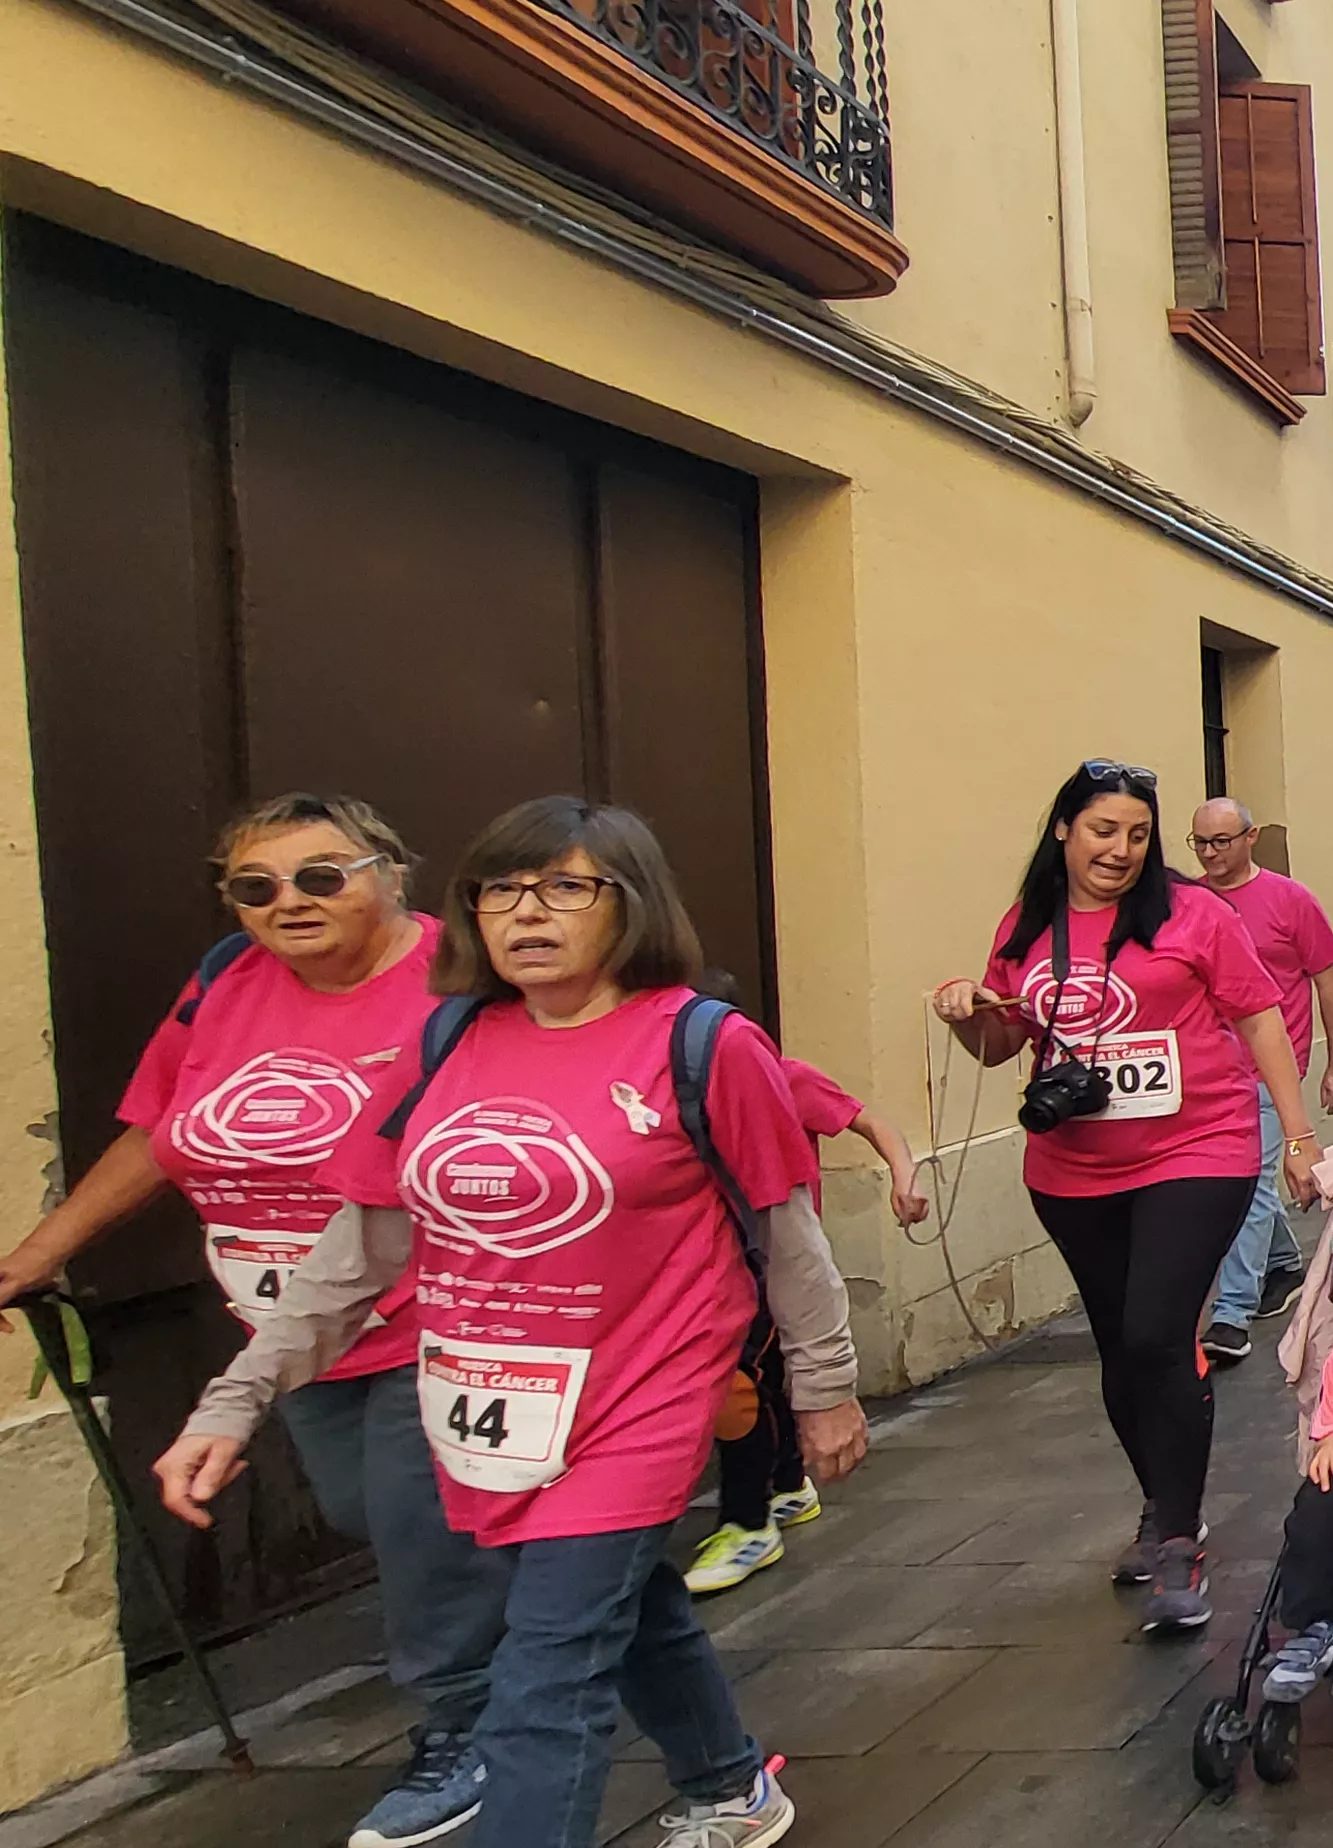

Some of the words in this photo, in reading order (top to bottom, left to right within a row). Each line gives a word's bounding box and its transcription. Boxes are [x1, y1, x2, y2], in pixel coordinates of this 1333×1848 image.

[450, 1178, 511, 1196] JUNTOS
[469, 1372, 486, 1387] EL
[488, 1371, 560, 1392] CÁNCER
[447, 1393, 510, 1450] 44
